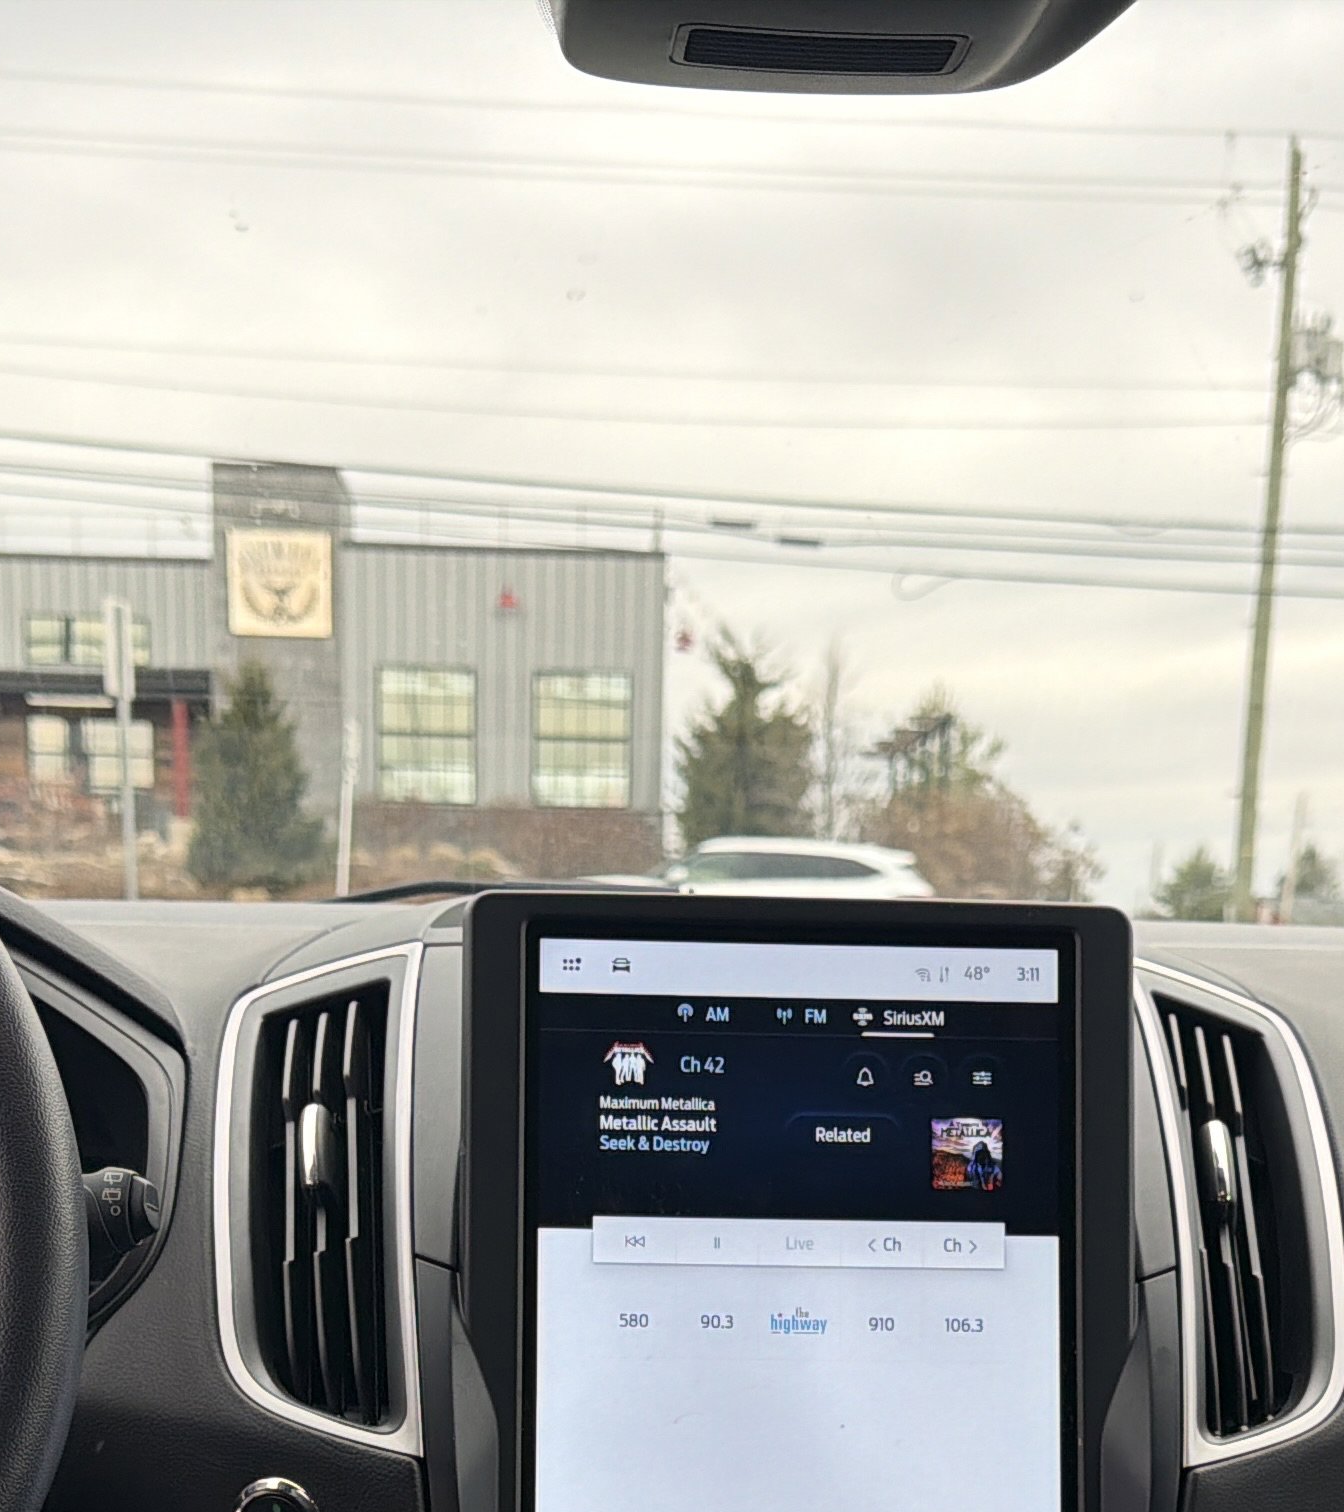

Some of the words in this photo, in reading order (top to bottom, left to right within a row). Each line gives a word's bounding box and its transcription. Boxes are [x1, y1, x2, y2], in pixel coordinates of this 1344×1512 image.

[1016, 966, 1040, 982] 3:11
[705, 1006, 730, 1023] AM
[804, 1008, 828, 1024] FM
[883, 1010, 945, 1027] SiriusXM
[680, 1055, 701, 1073] Ch
[703, 1056, 725, 1074] 42
[599, 1095, 659, 1111] Maximum
[661, 1097, 716, 1112] Metallica
[599, 1114, 659, 1131] Metallic
[660, 1115, 717, 1132] Assault
[815, 1126, 872, 1144] Related
[599, 1134, 636, 1151] Seek
[638, 1135, 650, 1151] &
[652, 1135, 710, 1154] Destroy
[785, 1235, 815, 1252] Live
[882, 1236, 902, 1253] Ch
[943, 1237, 962, 1254] Ch
[619, 1312, 649, 1329] 580
[700, 1313, 735, 1331] 90.3
[770, 1312, 828, 1335] highway
[868, 1316, 895, 1333] 910
[944, 1317, 984, 1334] 106.3
